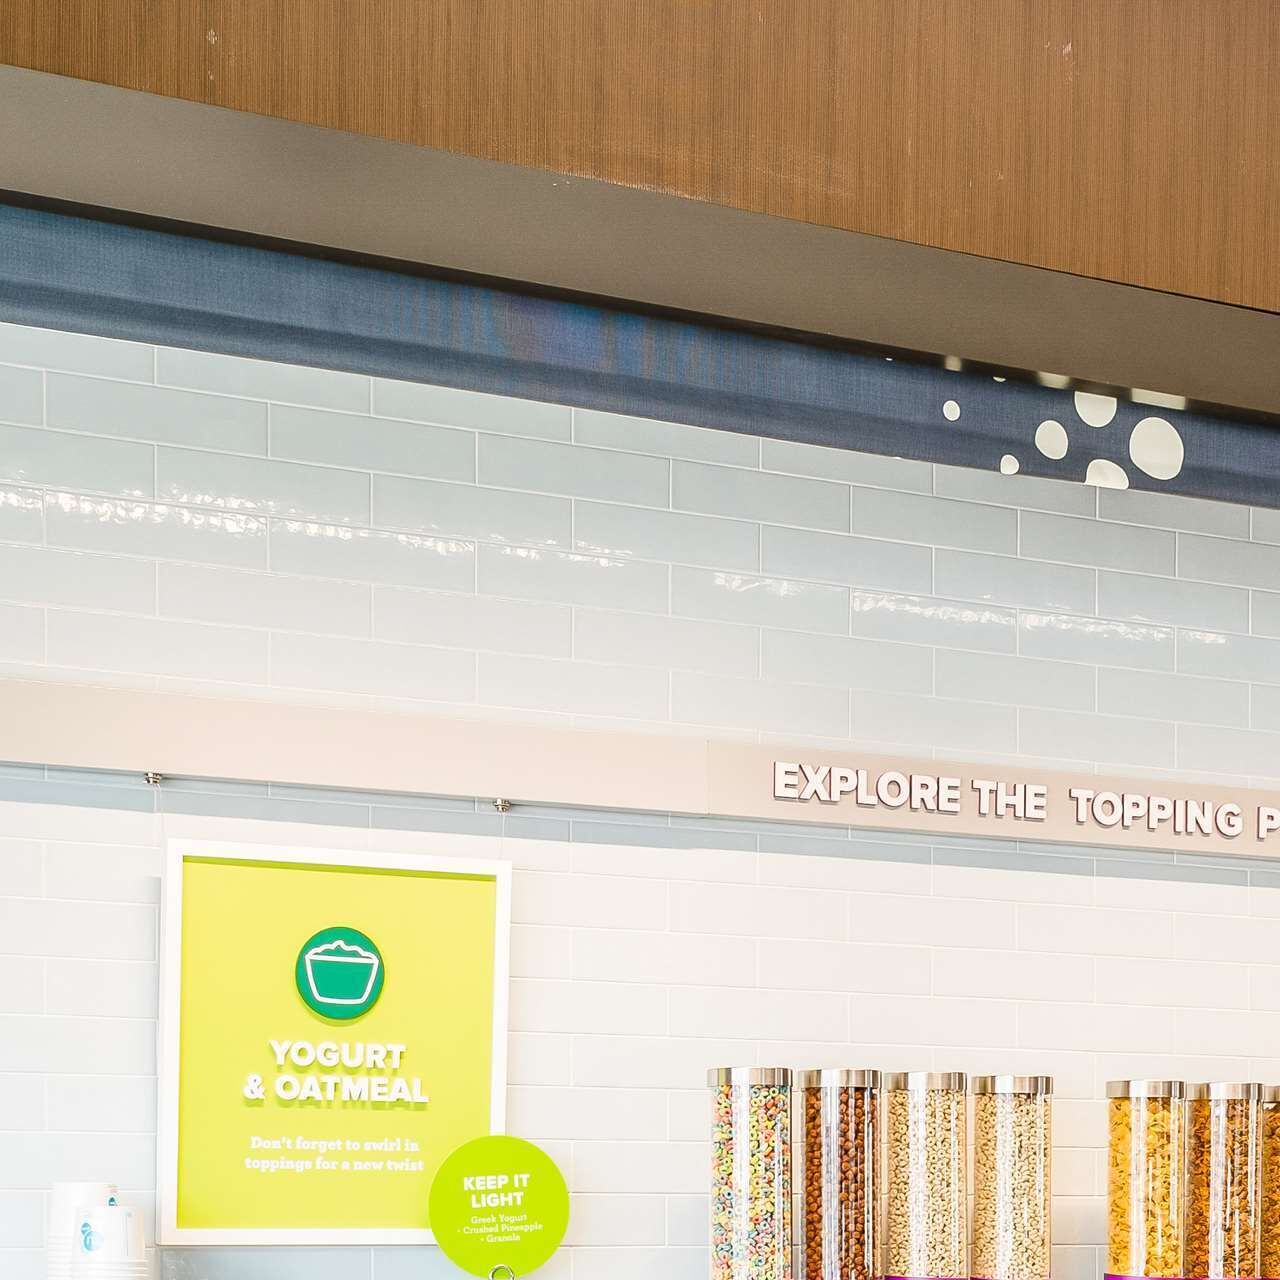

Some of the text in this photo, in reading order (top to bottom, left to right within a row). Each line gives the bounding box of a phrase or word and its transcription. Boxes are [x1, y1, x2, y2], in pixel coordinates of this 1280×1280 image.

[772, 761, 961, 813] EXPLORE
[972, 778, 1047, 820] THE
[1070, 788, 1243, 838] TOPPING
[269, 1040, 407, 1070] YOGURT
[243, 1073, 429, 1104] & OATMEAL
[250, 1136, 420, 1153] Don't forget to swirl in
[245, 1157, 424, 1173] toppings for a new twist
[463, 1174, 530, 1191] KEEP IT
[471, 1192, 524, 1208] LIGHT
[471, 1213, 527, 1224] Greek Yogurt
[463, 1221, 543, 1234] Crushed Pineapple
